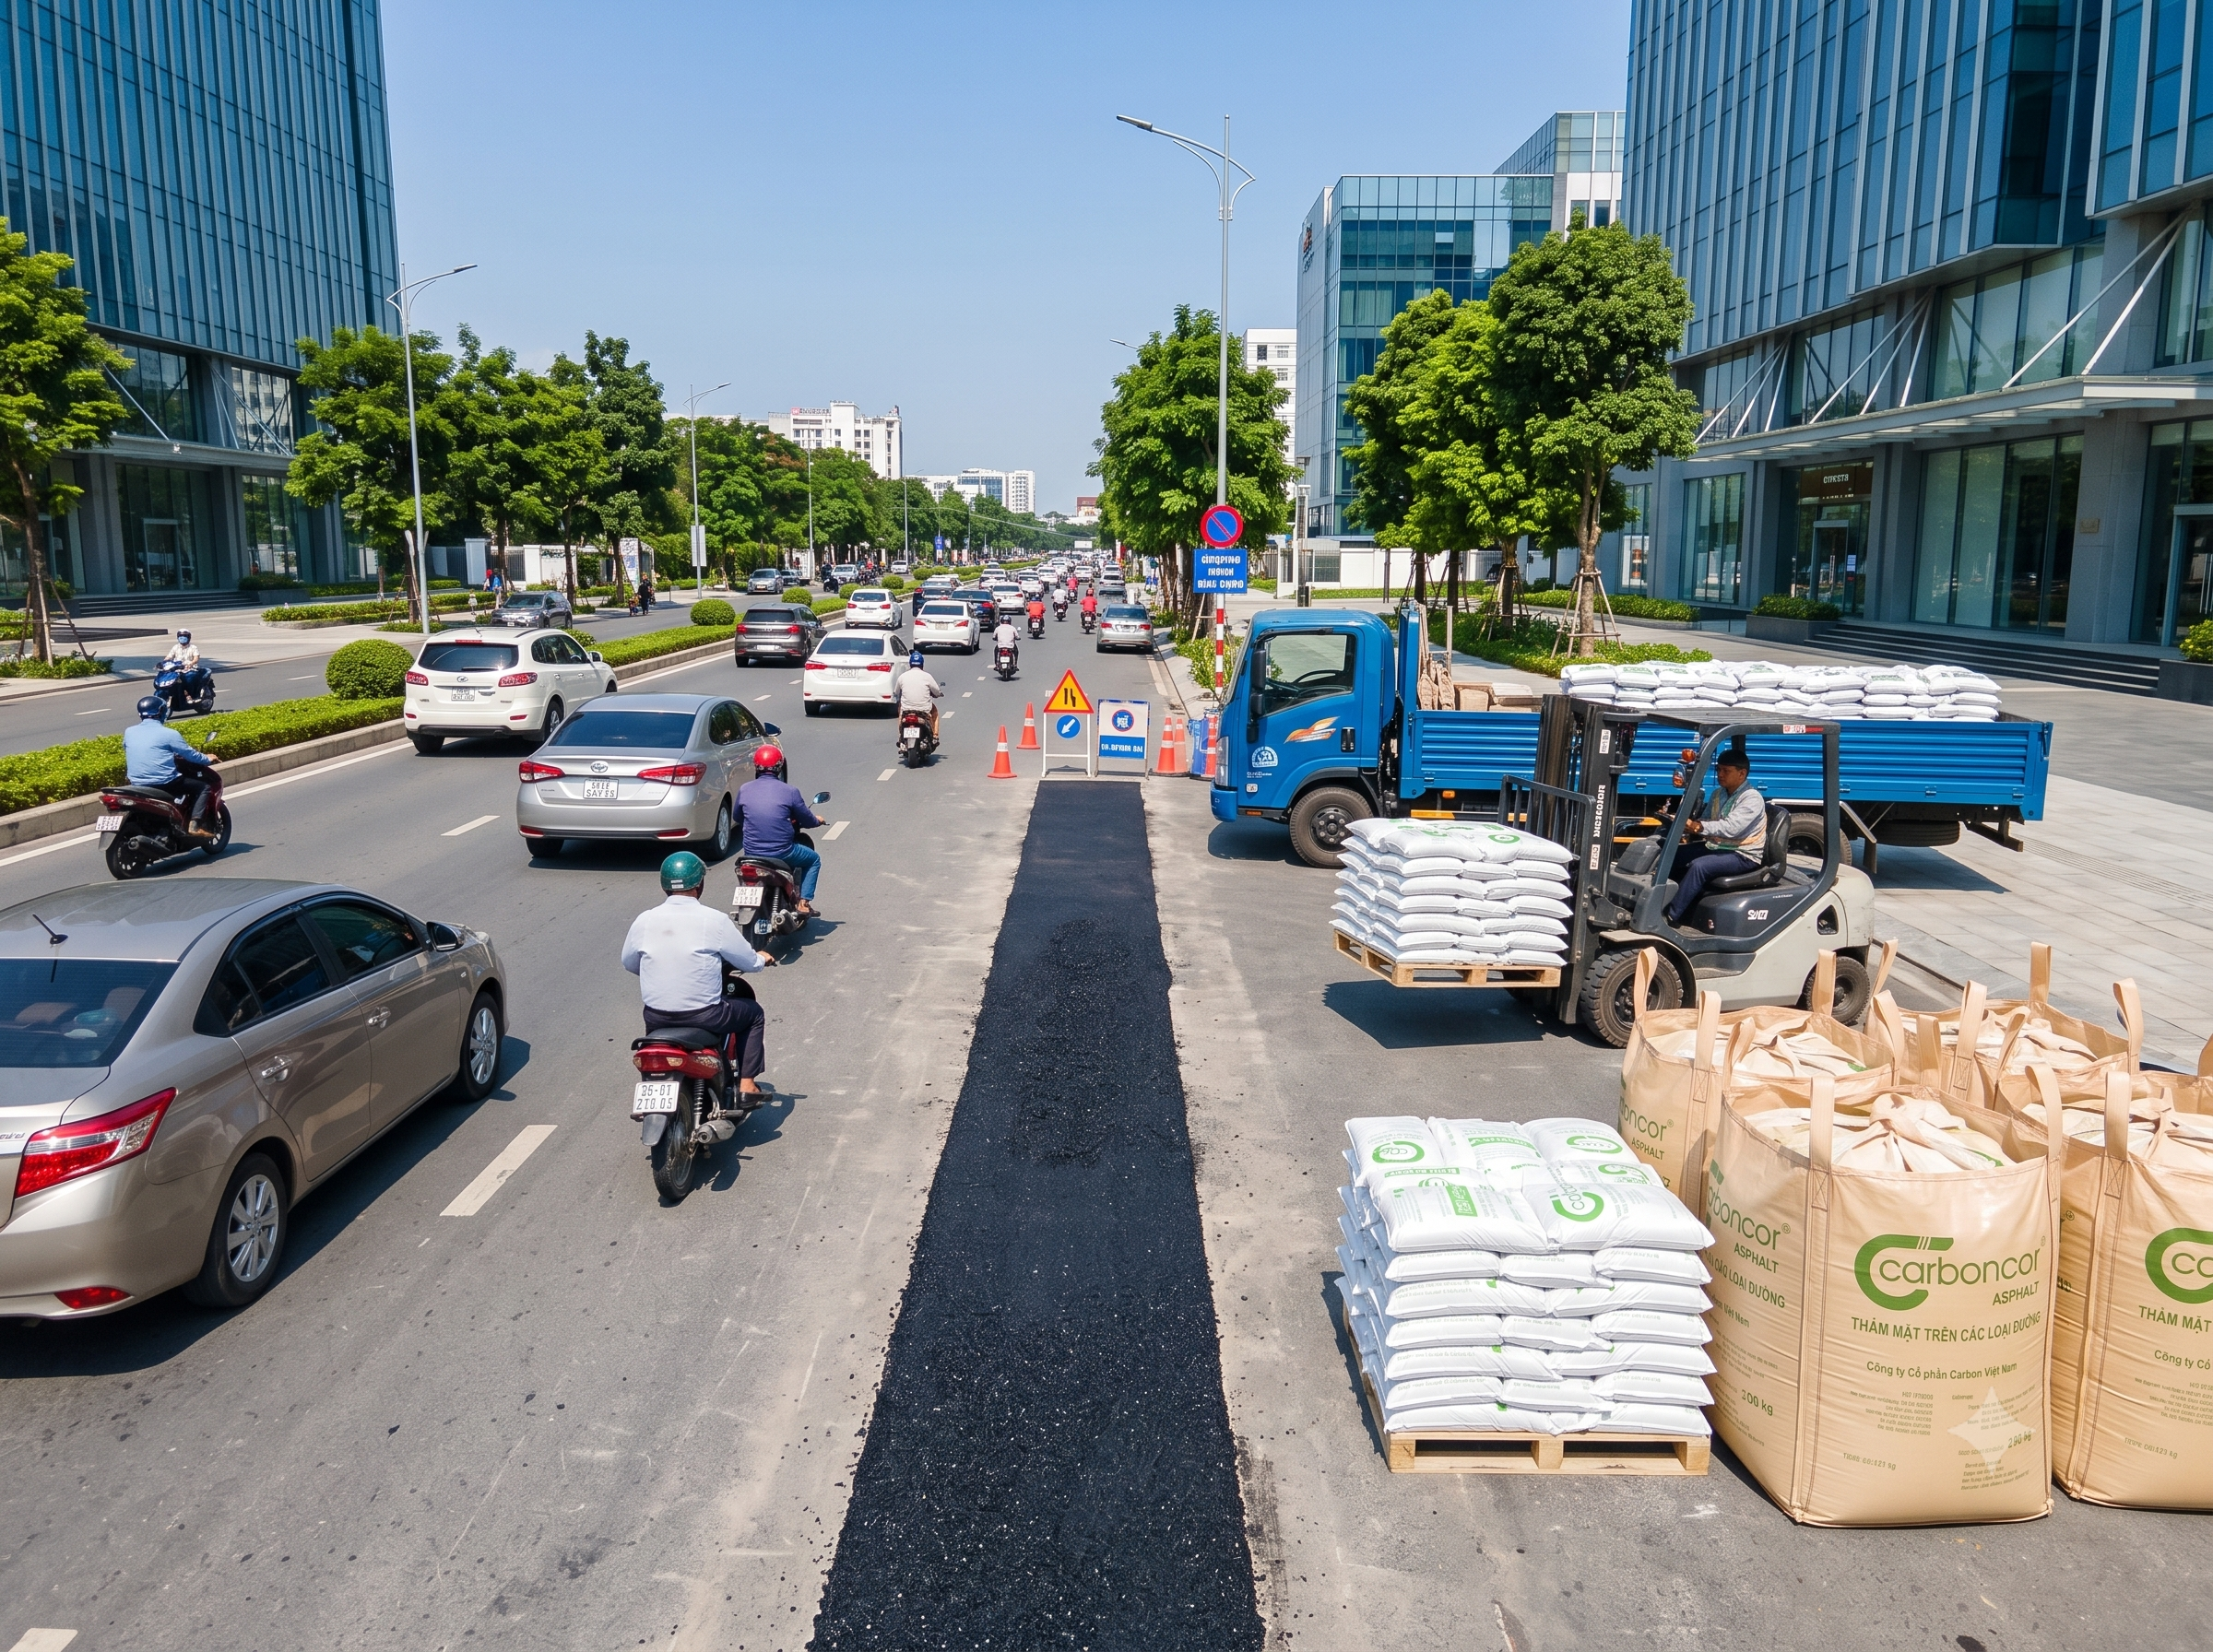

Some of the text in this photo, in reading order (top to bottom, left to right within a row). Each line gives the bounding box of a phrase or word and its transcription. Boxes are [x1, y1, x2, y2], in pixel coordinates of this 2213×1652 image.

[1631, 1137, 1665, 1161] ASPHALT
[1734, 1242, 1780, 1274] ASPHALT
[1879, 1248, 2041, 1286] carboncor
[1993, 1280, 2040, 1306] ASPHALT
[1892, 1323, 1921, 1342] MẶT
[1960, 1325, 1984, 1342] CÁC
[1987, 1322, 2011, 1339] LOẠI
[1896, 1366, 1905, 1378] ty
[1950, 1370, 1982, 1379] Carbon
[1984, 1365, 2000, 1378] Việt
[2184, 1357, 2194, 1369] ty
[1761, 1399, 1773, 1416] kg
